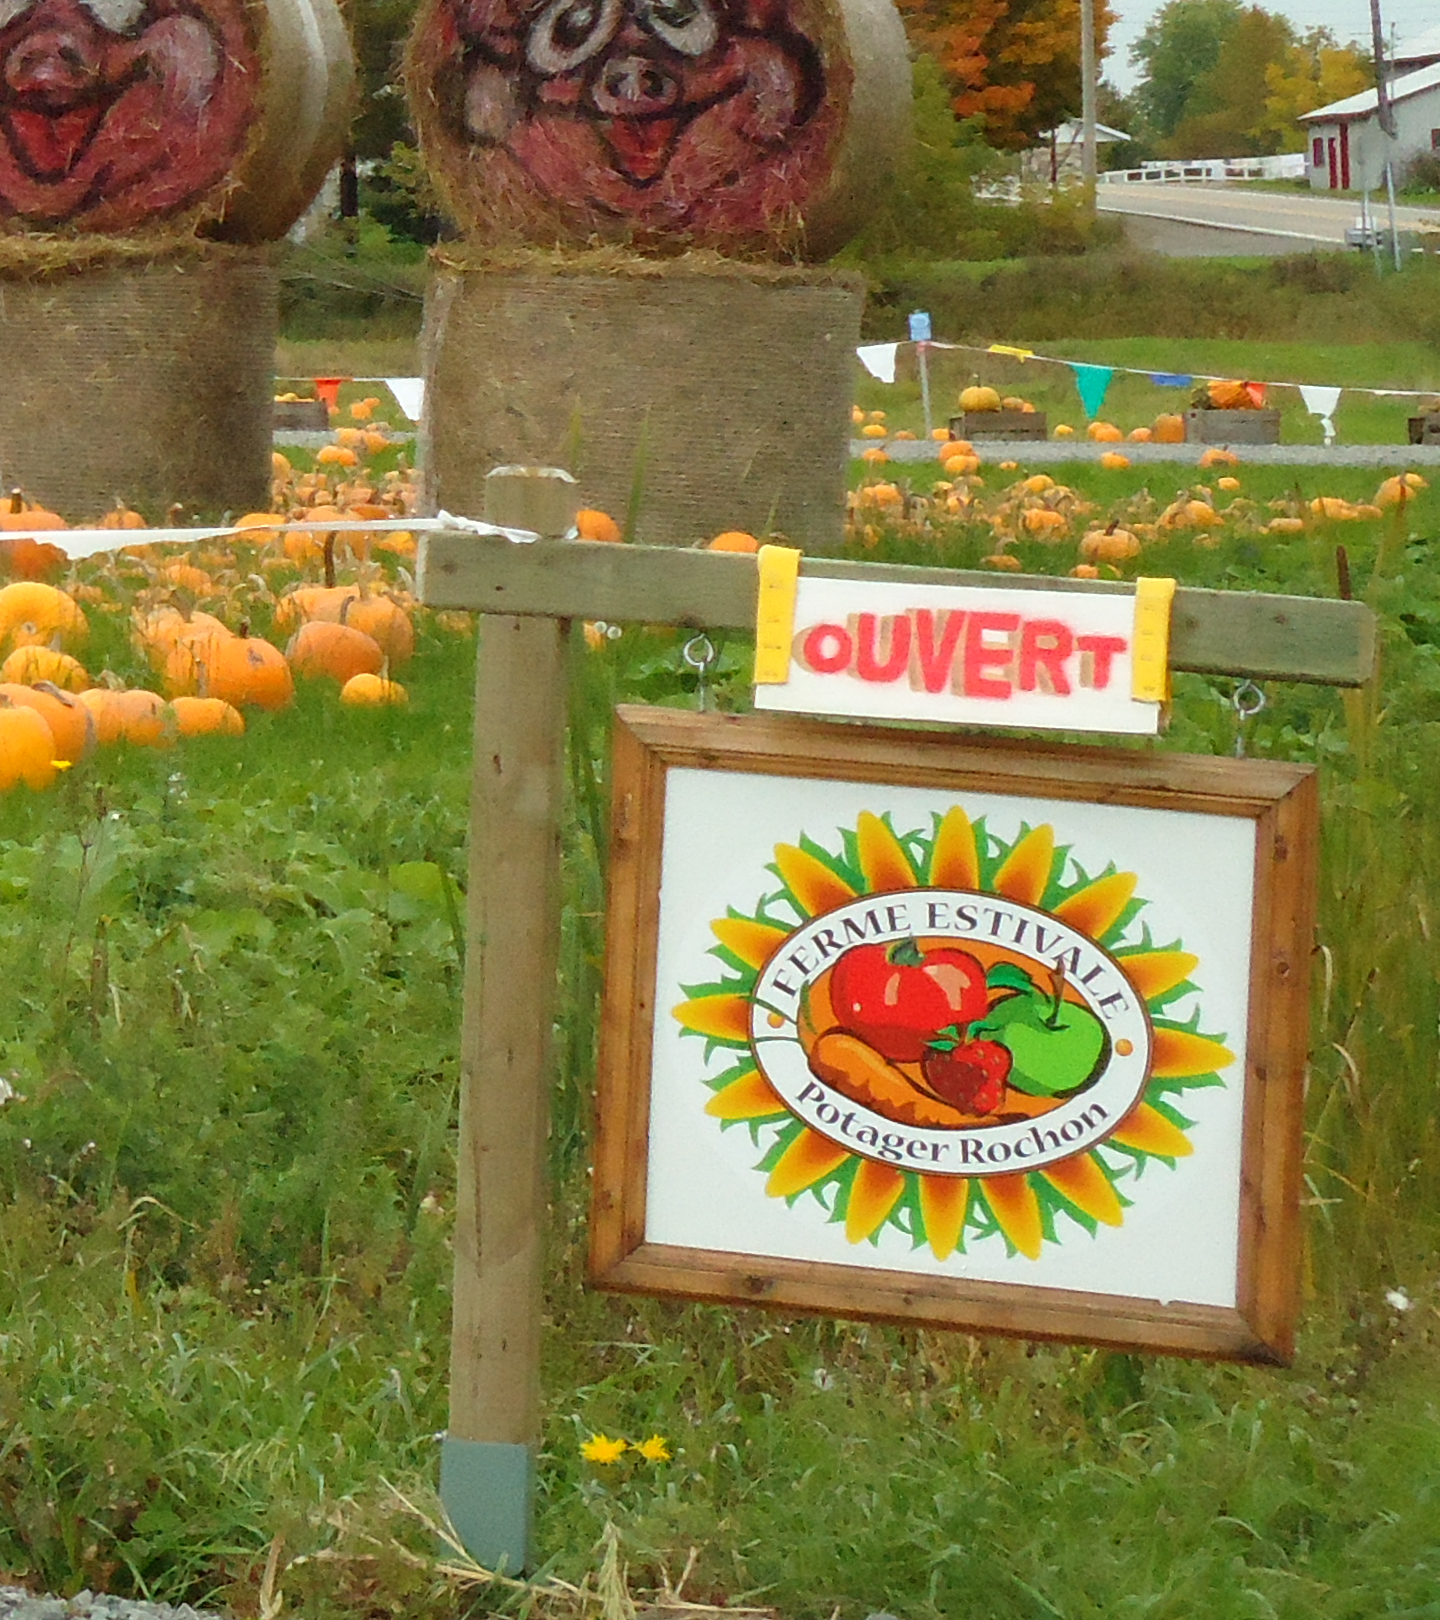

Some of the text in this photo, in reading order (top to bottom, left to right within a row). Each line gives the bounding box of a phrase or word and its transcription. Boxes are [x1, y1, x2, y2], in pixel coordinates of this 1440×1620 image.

[794, 607, 1128, 701] OUVERT
[772, 900, 1130, 1021] FERME ESTIVALE
[794, 1080, 1111, 1165] Potager Rochon
